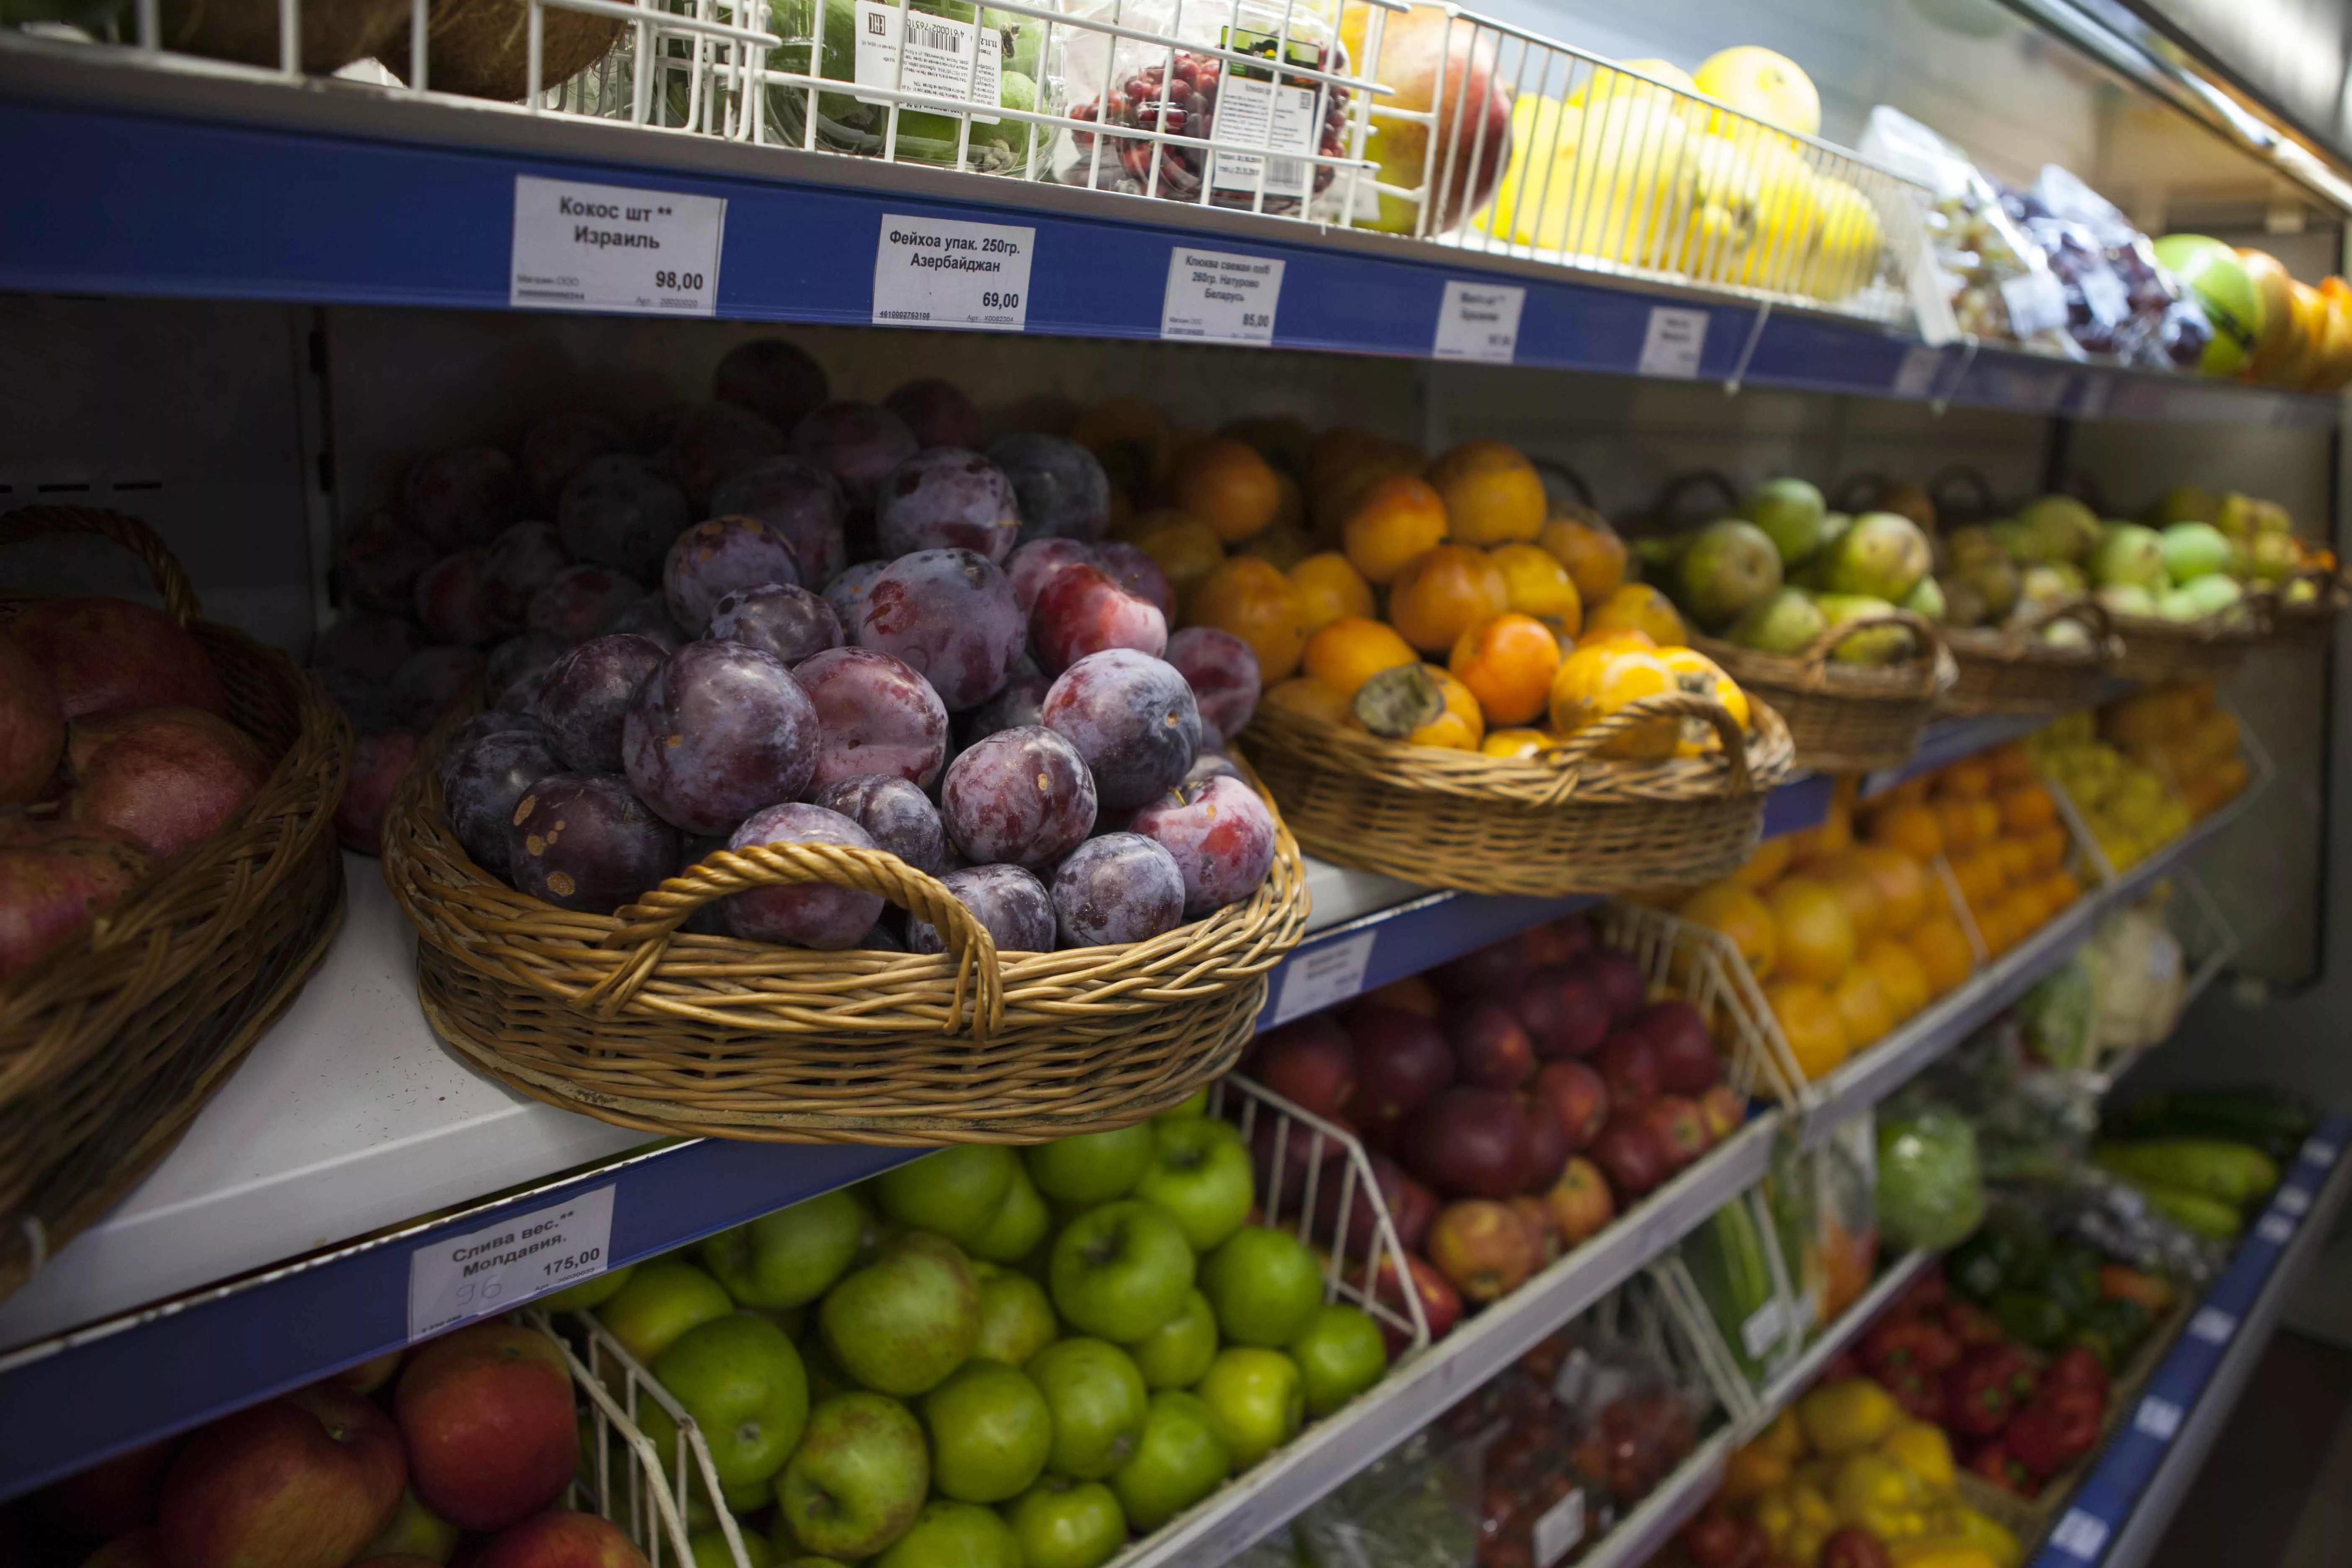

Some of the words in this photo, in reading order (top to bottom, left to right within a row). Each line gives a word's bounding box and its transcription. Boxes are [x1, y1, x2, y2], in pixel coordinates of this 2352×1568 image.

[932, 24, 959, 37] 610002
[560, 195, 619, 219] Кокос
[625, 208, 652, 222] шт
[574, 225, 660, 250] Израиль
[890, 230, 941, 248] Фейхоа
[945, 237, 978, 251] упак.
[982, 238, 1020, 256] 250гр.
[910, 253, 1001, 272] Азербайджан
[655, 270, 703, 291] 98,00
[983, 292, 1019, 309] 69,00
[1204, 288, 1245, 302] Беларусь
[452, 1233, 515, 1263] Слива
[463, 1234, 567, 1278] Молдавия.
[543, 1248, 600, 1277] 175,00
